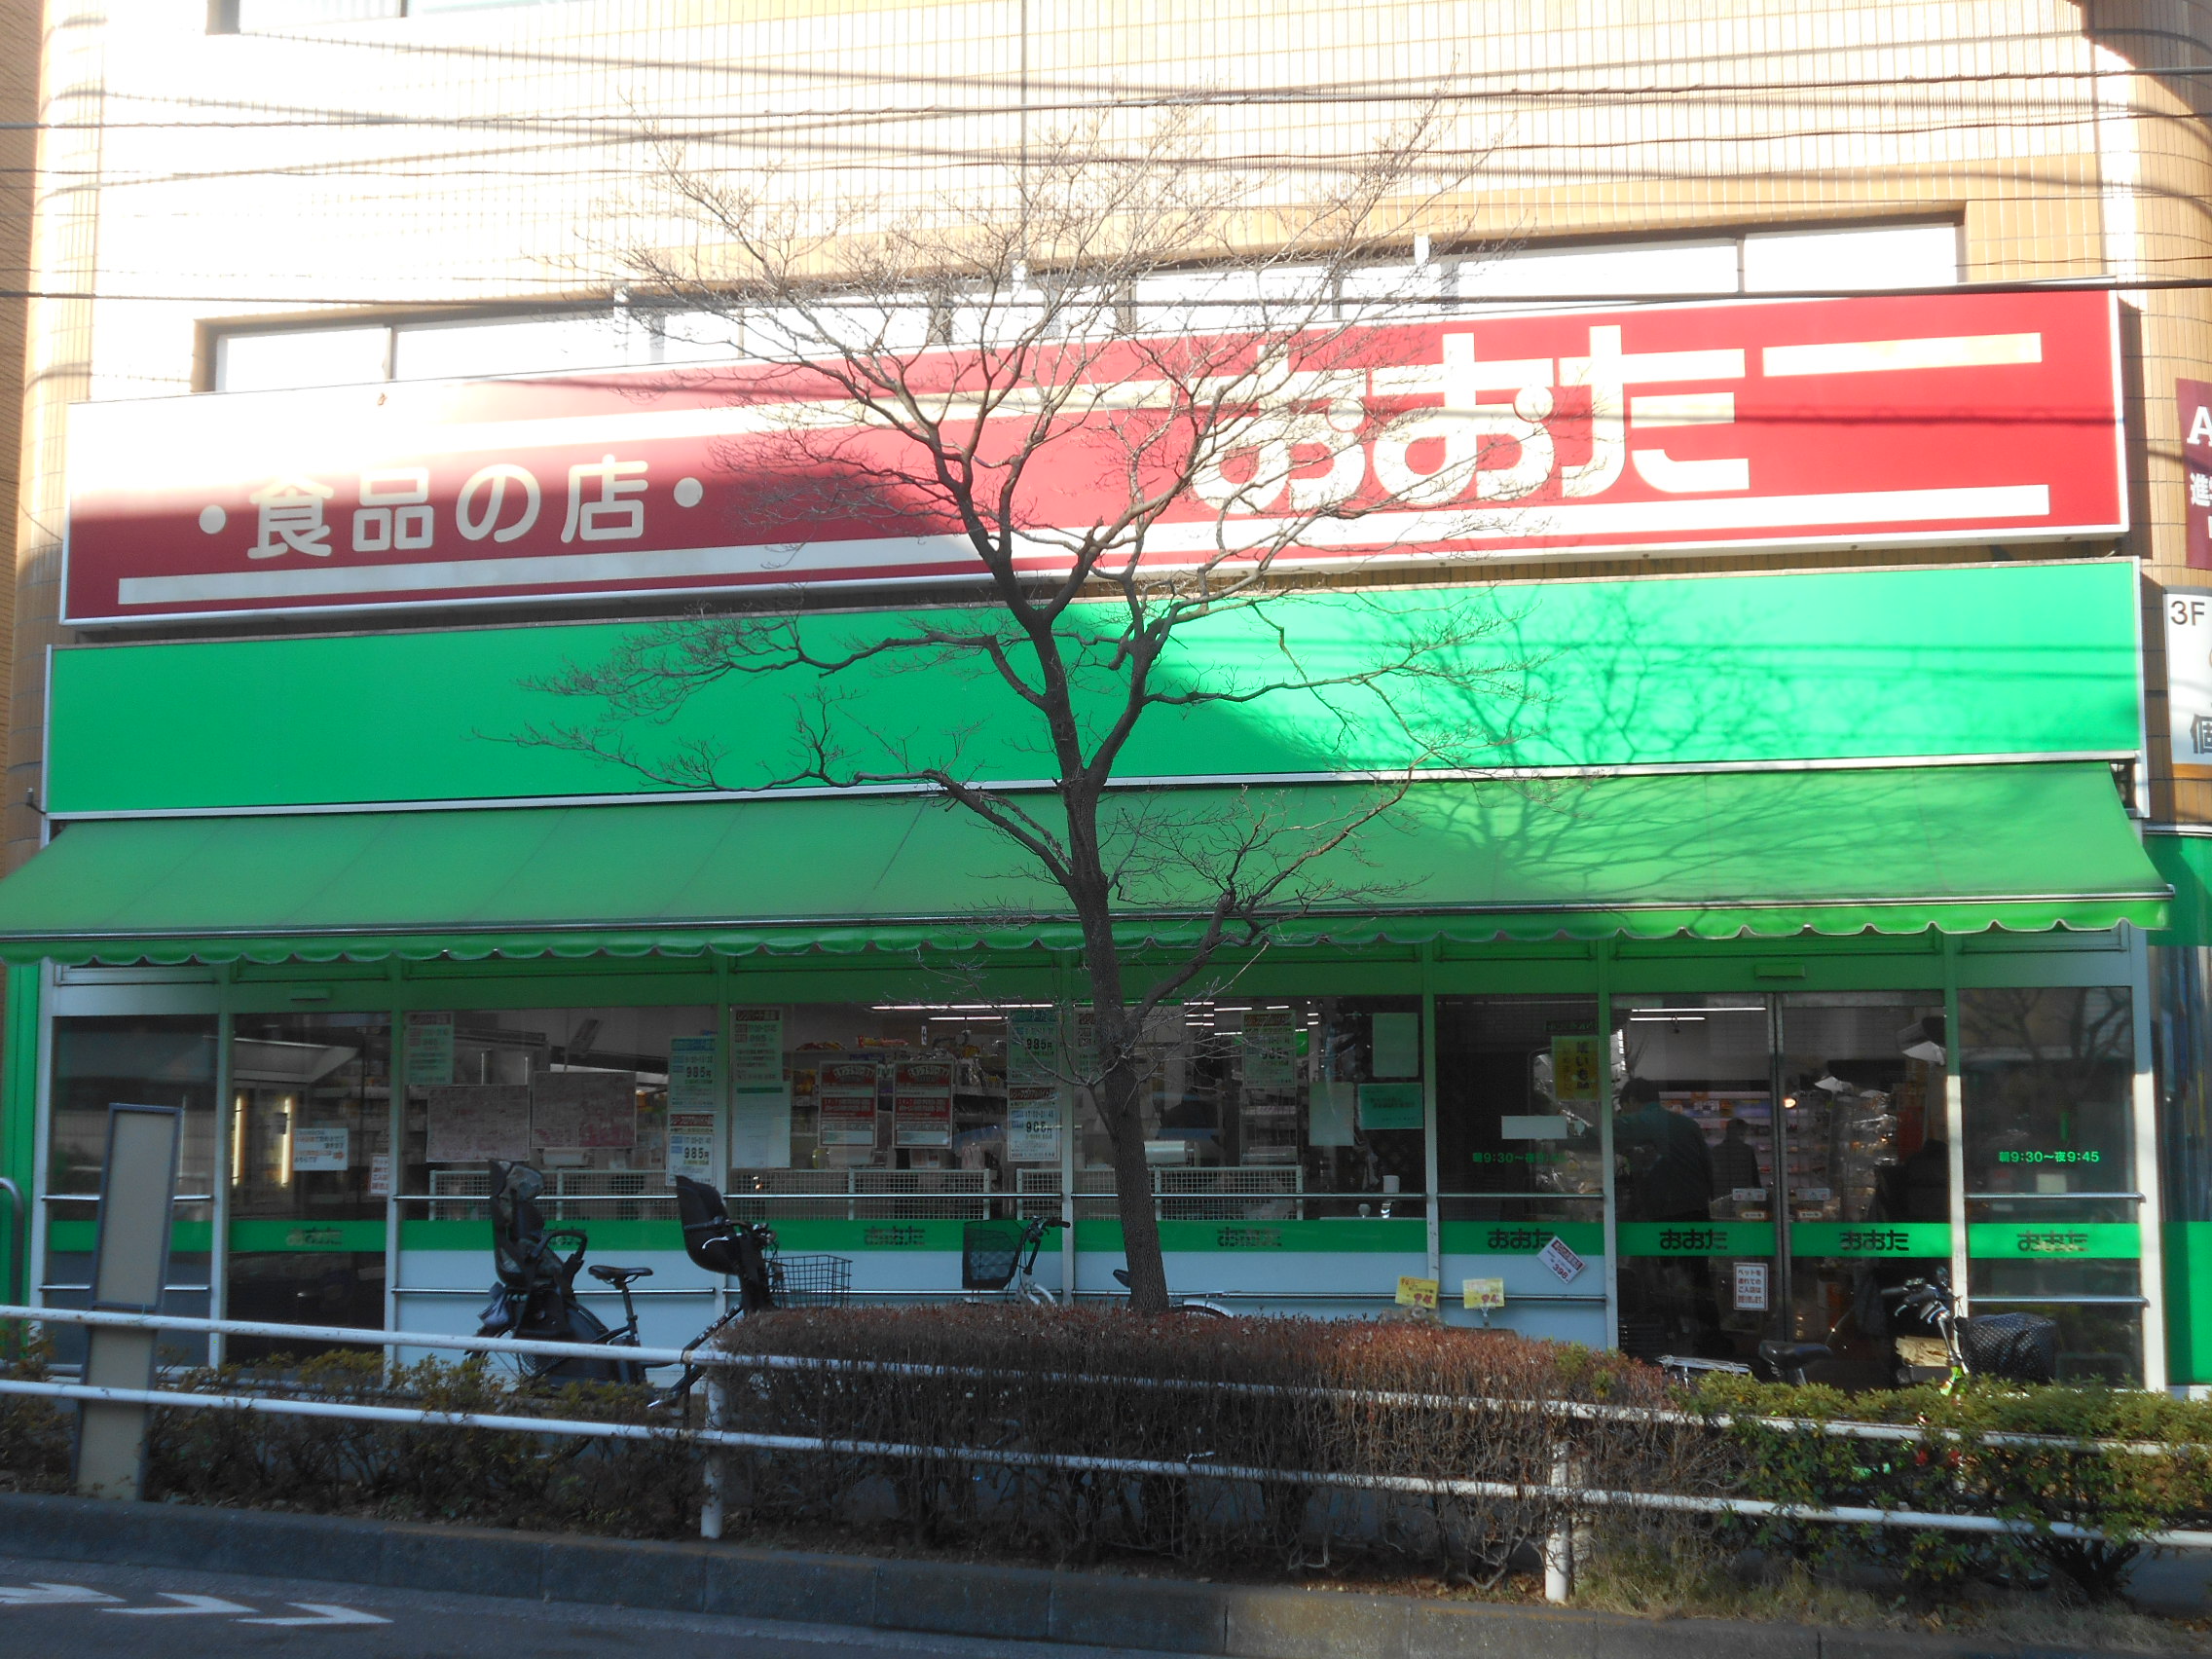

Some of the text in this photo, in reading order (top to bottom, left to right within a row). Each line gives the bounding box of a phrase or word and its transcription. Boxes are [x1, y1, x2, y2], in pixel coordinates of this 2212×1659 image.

[1188, 324, 1750, 514] おおた
[2191, 472, 2212, 507] 進
[2170, 600, 2205, 626] 3F
[1659, 1229, 1728, 1250] おおた
[1839, 1230, 1908, 1250] おおた
[2016, 1230, 2089, 1252] おおた
